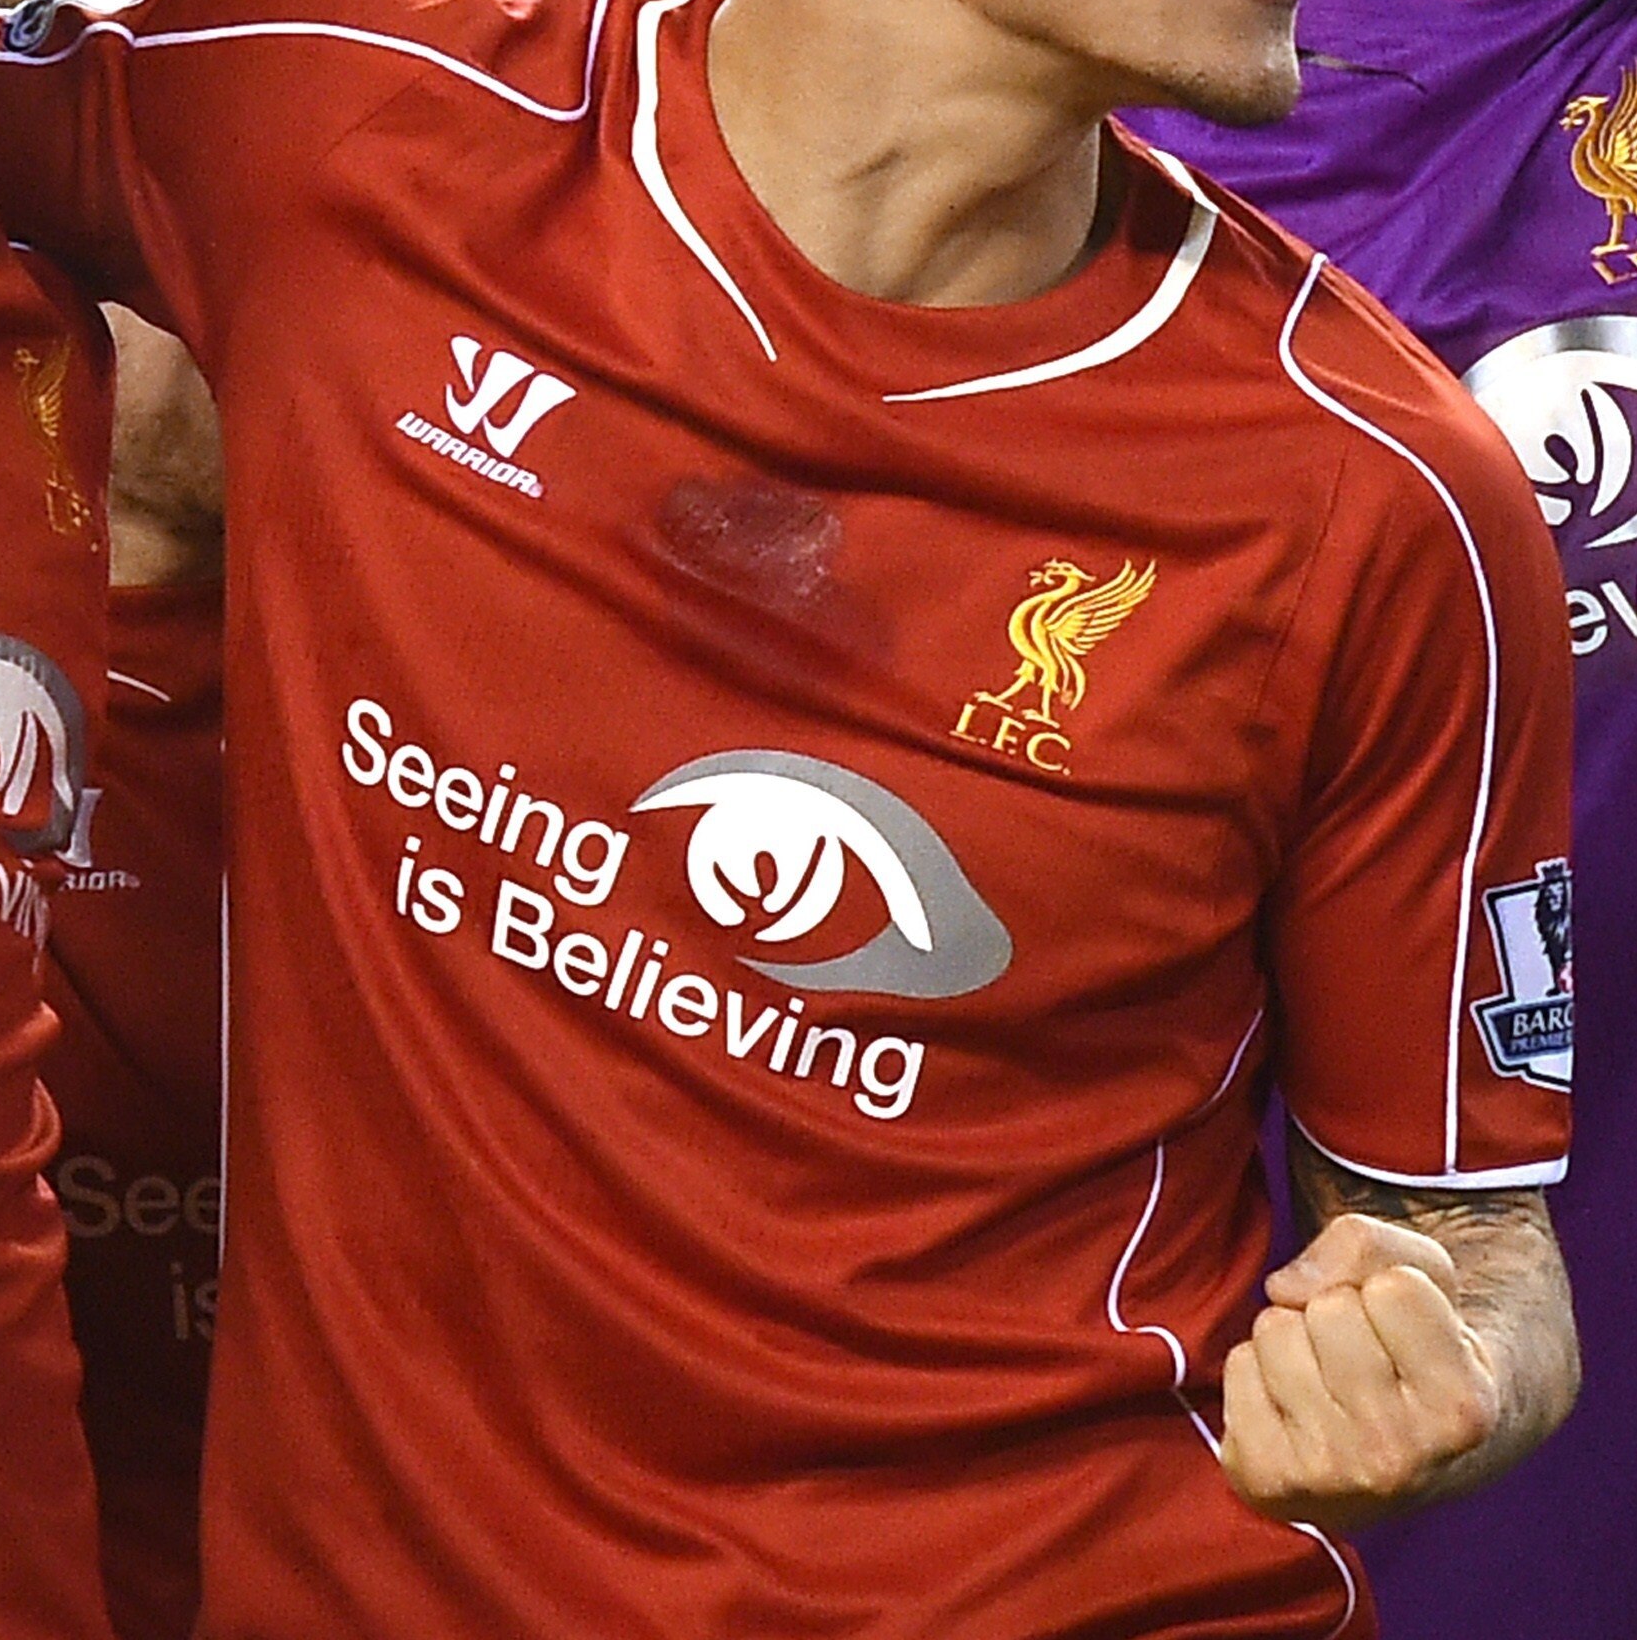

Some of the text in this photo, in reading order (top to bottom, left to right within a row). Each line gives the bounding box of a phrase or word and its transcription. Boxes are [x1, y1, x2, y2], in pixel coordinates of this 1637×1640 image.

[395, 411, 539, 495] WARRIOR
[342, 698, 630, 907] Seeing
[395, 836, 925, 1120] is Believing
